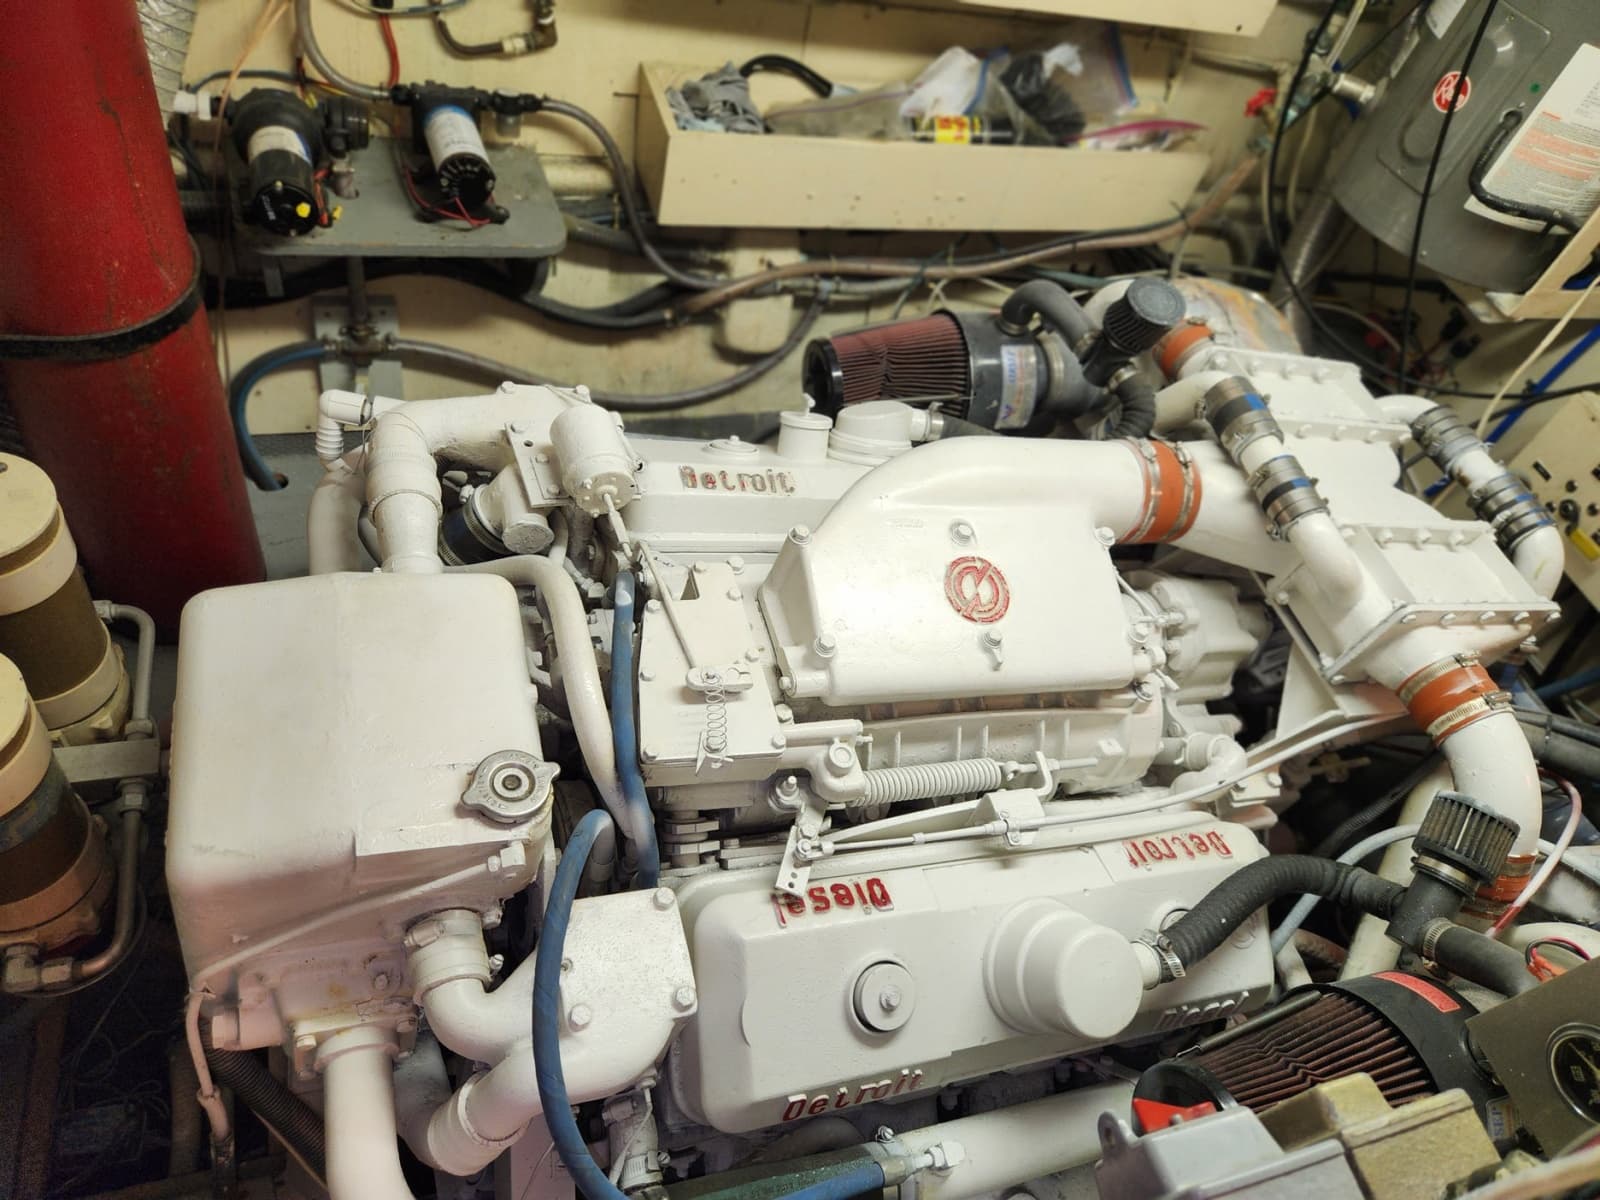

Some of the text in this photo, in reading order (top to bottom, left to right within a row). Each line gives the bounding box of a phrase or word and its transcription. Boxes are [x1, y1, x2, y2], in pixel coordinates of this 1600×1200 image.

[679, 464, 798, 495] Detroit
[769, 831, 1233, 928] Detroit Diesel
[782, 1068, 924, 1121] Detroit
